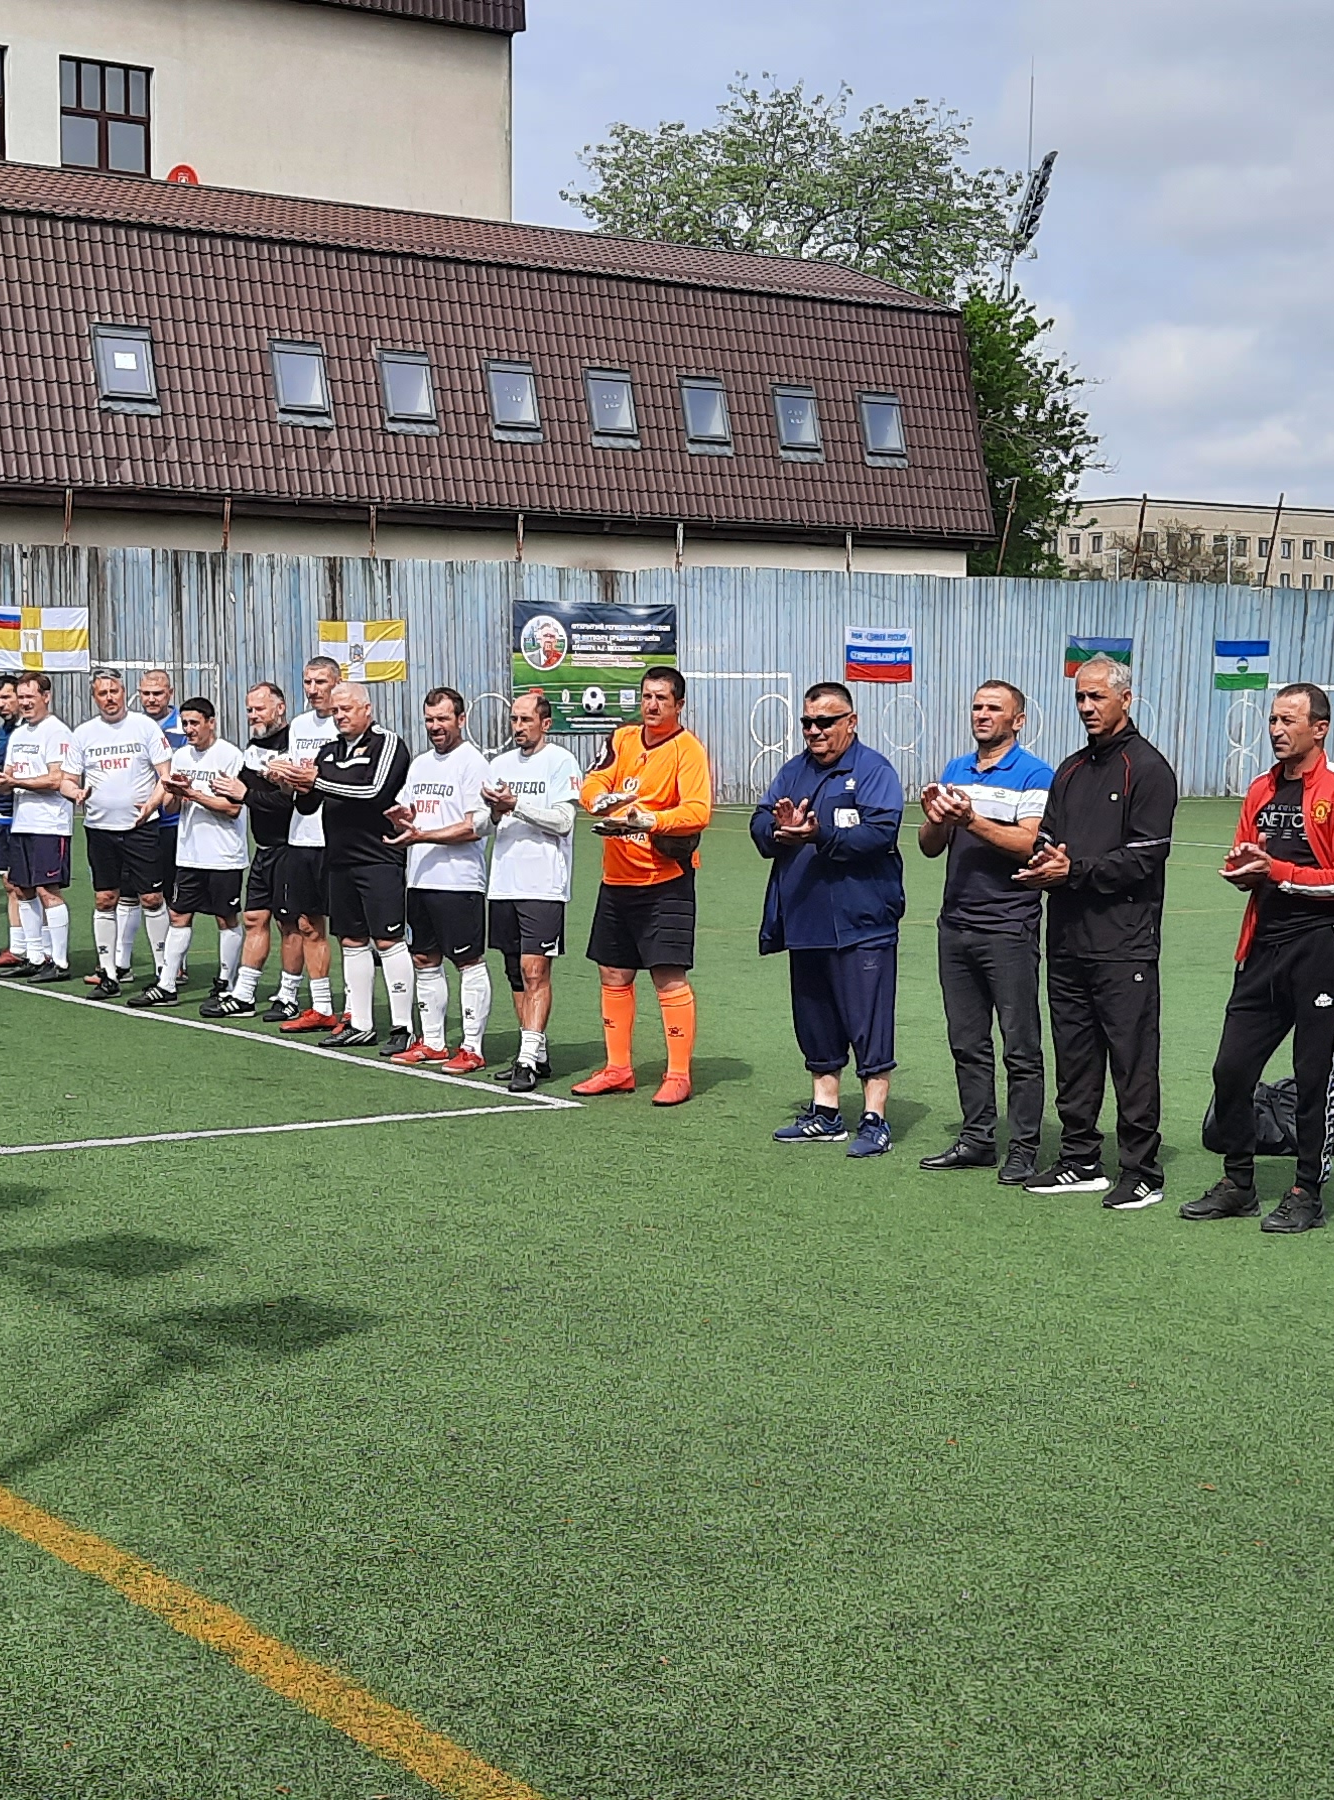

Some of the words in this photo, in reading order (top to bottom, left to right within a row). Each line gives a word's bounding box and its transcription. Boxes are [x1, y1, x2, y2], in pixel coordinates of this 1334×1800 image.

[88, 742, 142, 757] ТОРПЕДО
[99, 757, 130, 771] ЮКГ
[413, 783, 454, 797] ОРПЕДО
